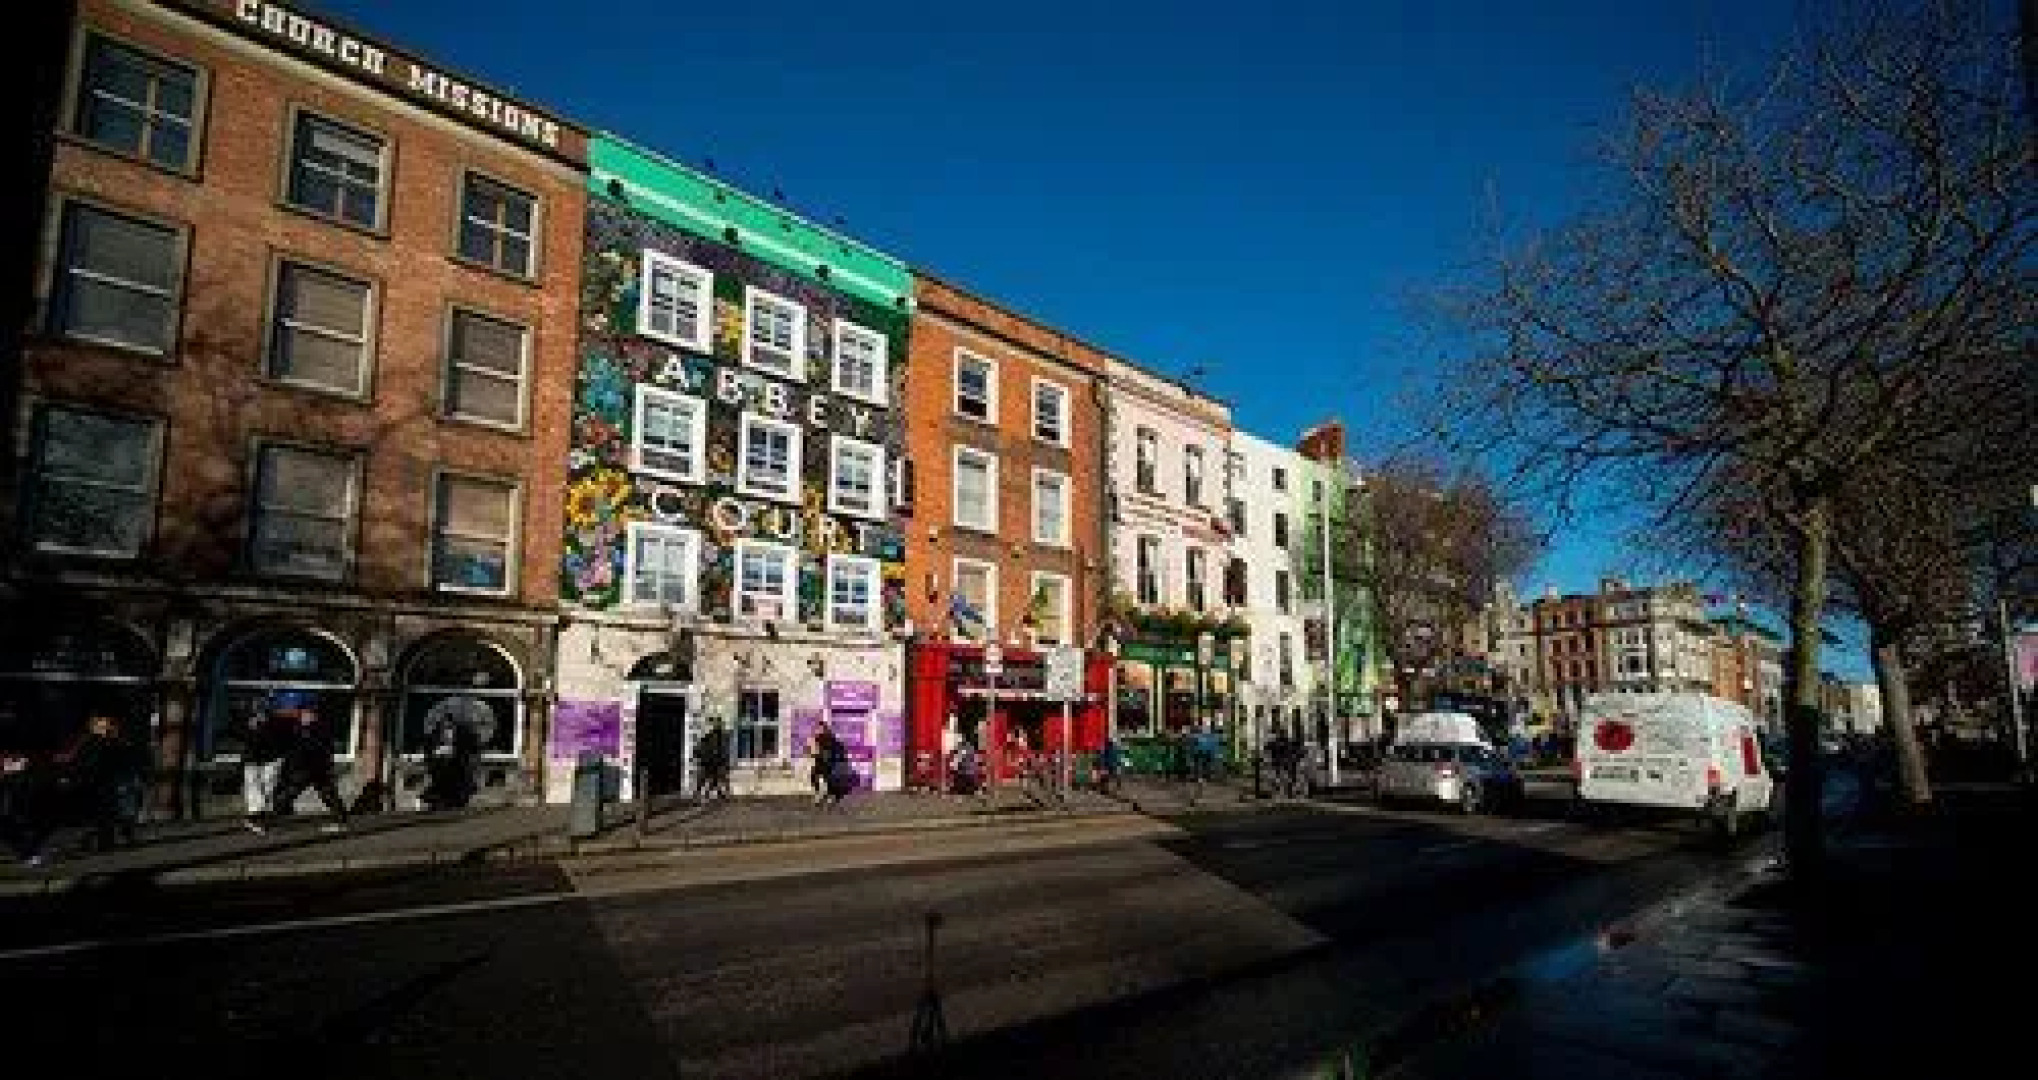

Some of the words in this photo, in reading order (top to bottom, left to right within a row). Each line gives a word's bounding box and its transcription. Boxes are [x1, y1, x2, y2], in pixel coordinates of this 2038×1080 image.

[235, 0, 386, 75] CHURCH
[407, 63, 560, 148] MISSIONS
[655, 353, 873, 435] ABBEY
[651, 485, 876, 551] COURT
